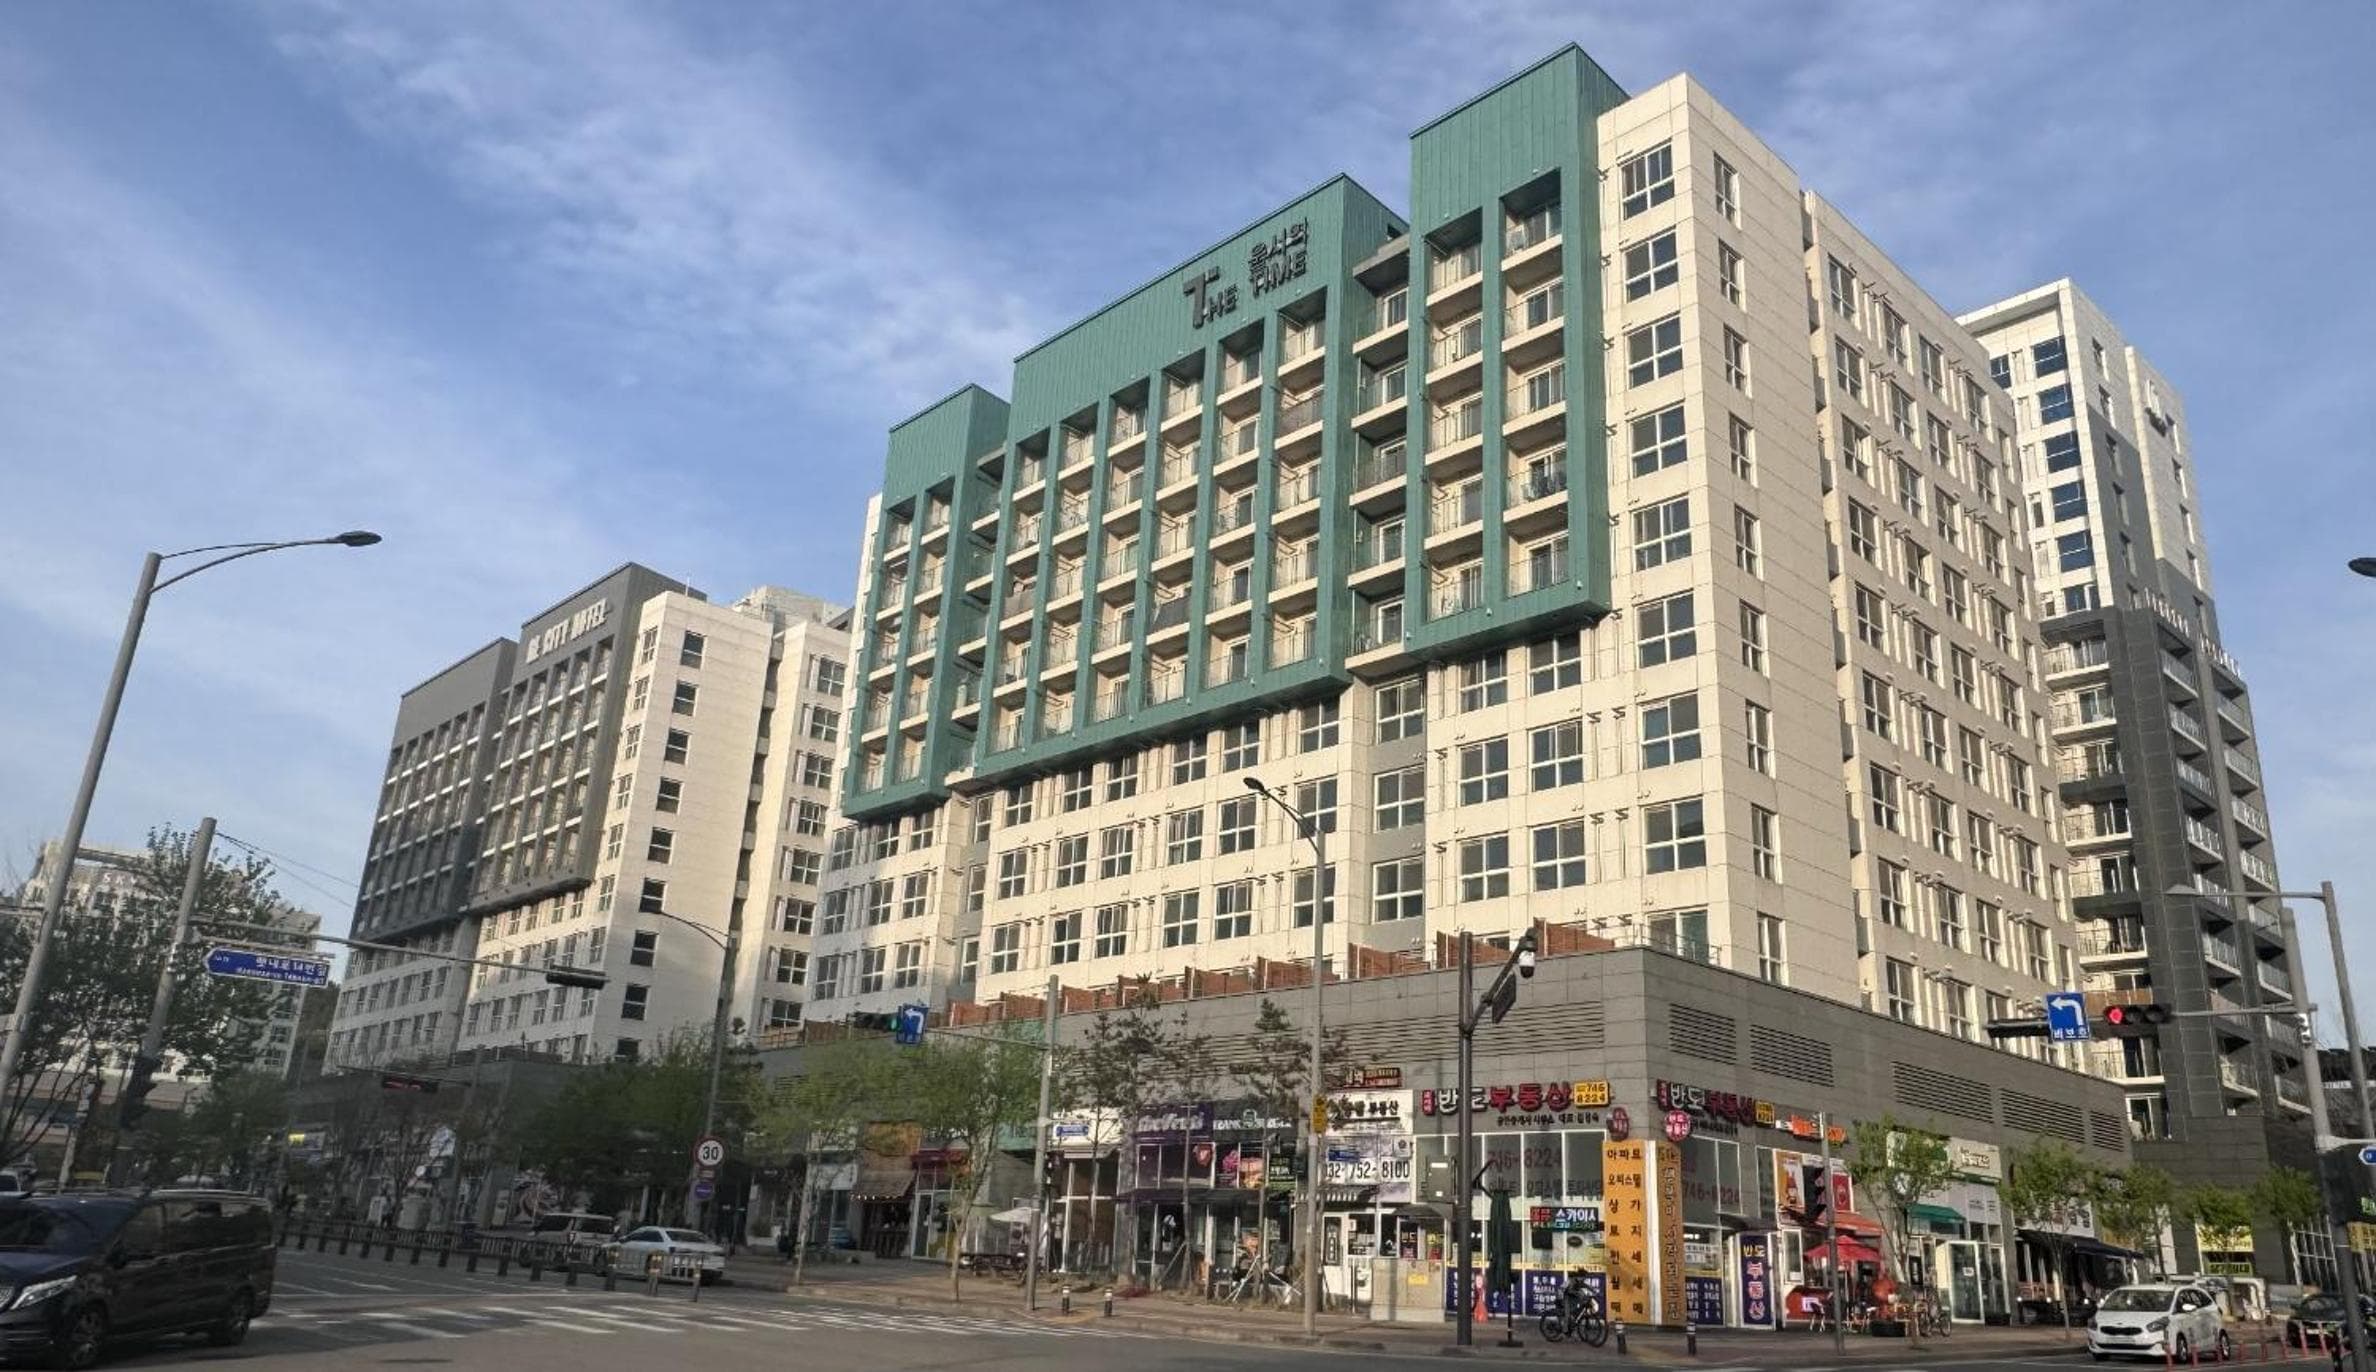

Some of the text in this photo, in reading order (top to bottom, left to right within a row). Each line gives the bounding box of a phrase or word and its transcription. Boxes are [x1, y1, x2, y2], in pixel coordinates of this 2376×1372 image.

[1247, 216, 1309, 283] 운서역
[1182, 249, 1307, 329] THE TIME
[702, 1145, 720, 1161] 30
[1607, 1148, 1642, 1161] 아파트
[1607, 1174, 1642, 1188] 오피스텔
[1556, 1208, 1597, 1222] 스카이시
[1746, 1261, 1765, 1320] 부동산
